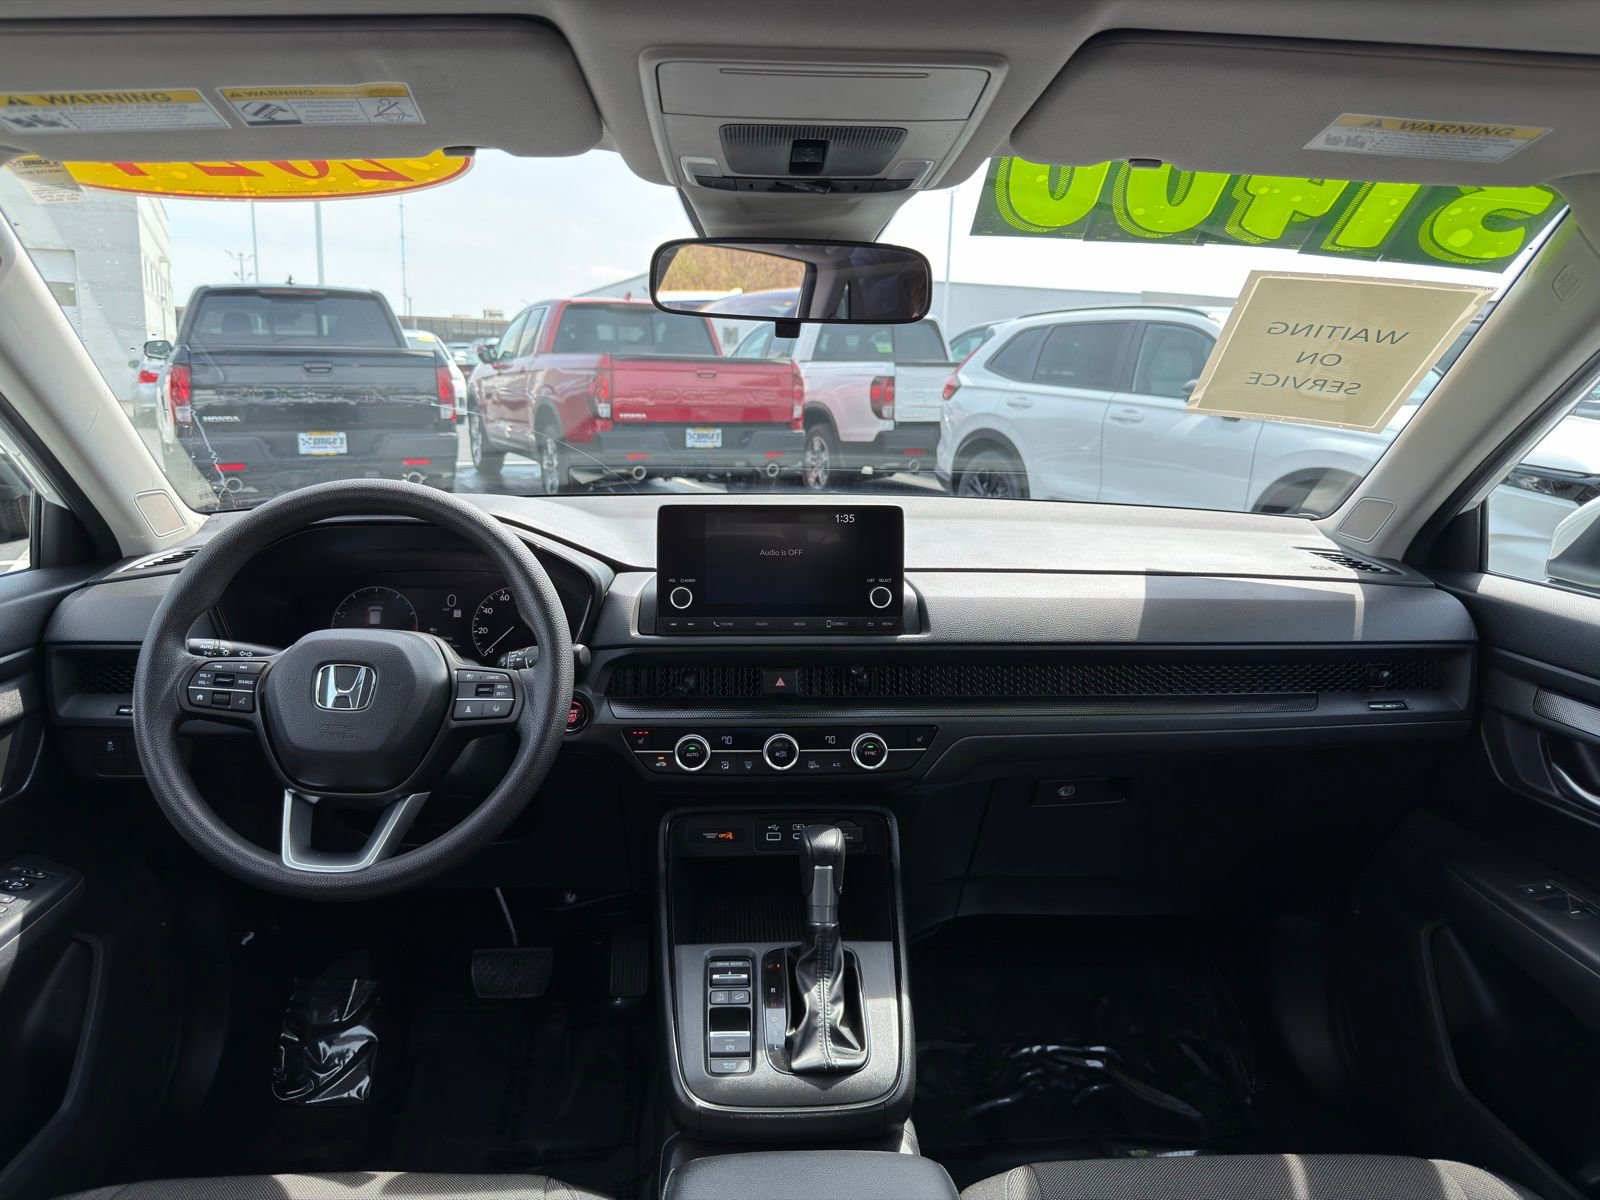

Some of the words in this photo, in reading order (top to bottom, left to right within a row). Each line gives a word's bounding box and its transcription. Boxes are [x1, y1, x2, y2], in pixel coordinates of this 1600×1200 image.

[242, 88, 315, 98] WARNING
[38, 91, 173, 106] WARNING
[1398, 121, 1517, 136] WARNING
[203, 415, 241, 423] HONDA
[835, 513, 855, 524] 1:35
[759, 548, 779, 557] Audio
[781, 548, 787, 557] is
[788, 548, 803, 557] OFF
[499, 594, 510, 602] 60
[482, 607, 493, 615] 40
[478, 626, 489, 634] 20
[721, 735, 733, 745] 70
[825, 735, 836, 745] 70
